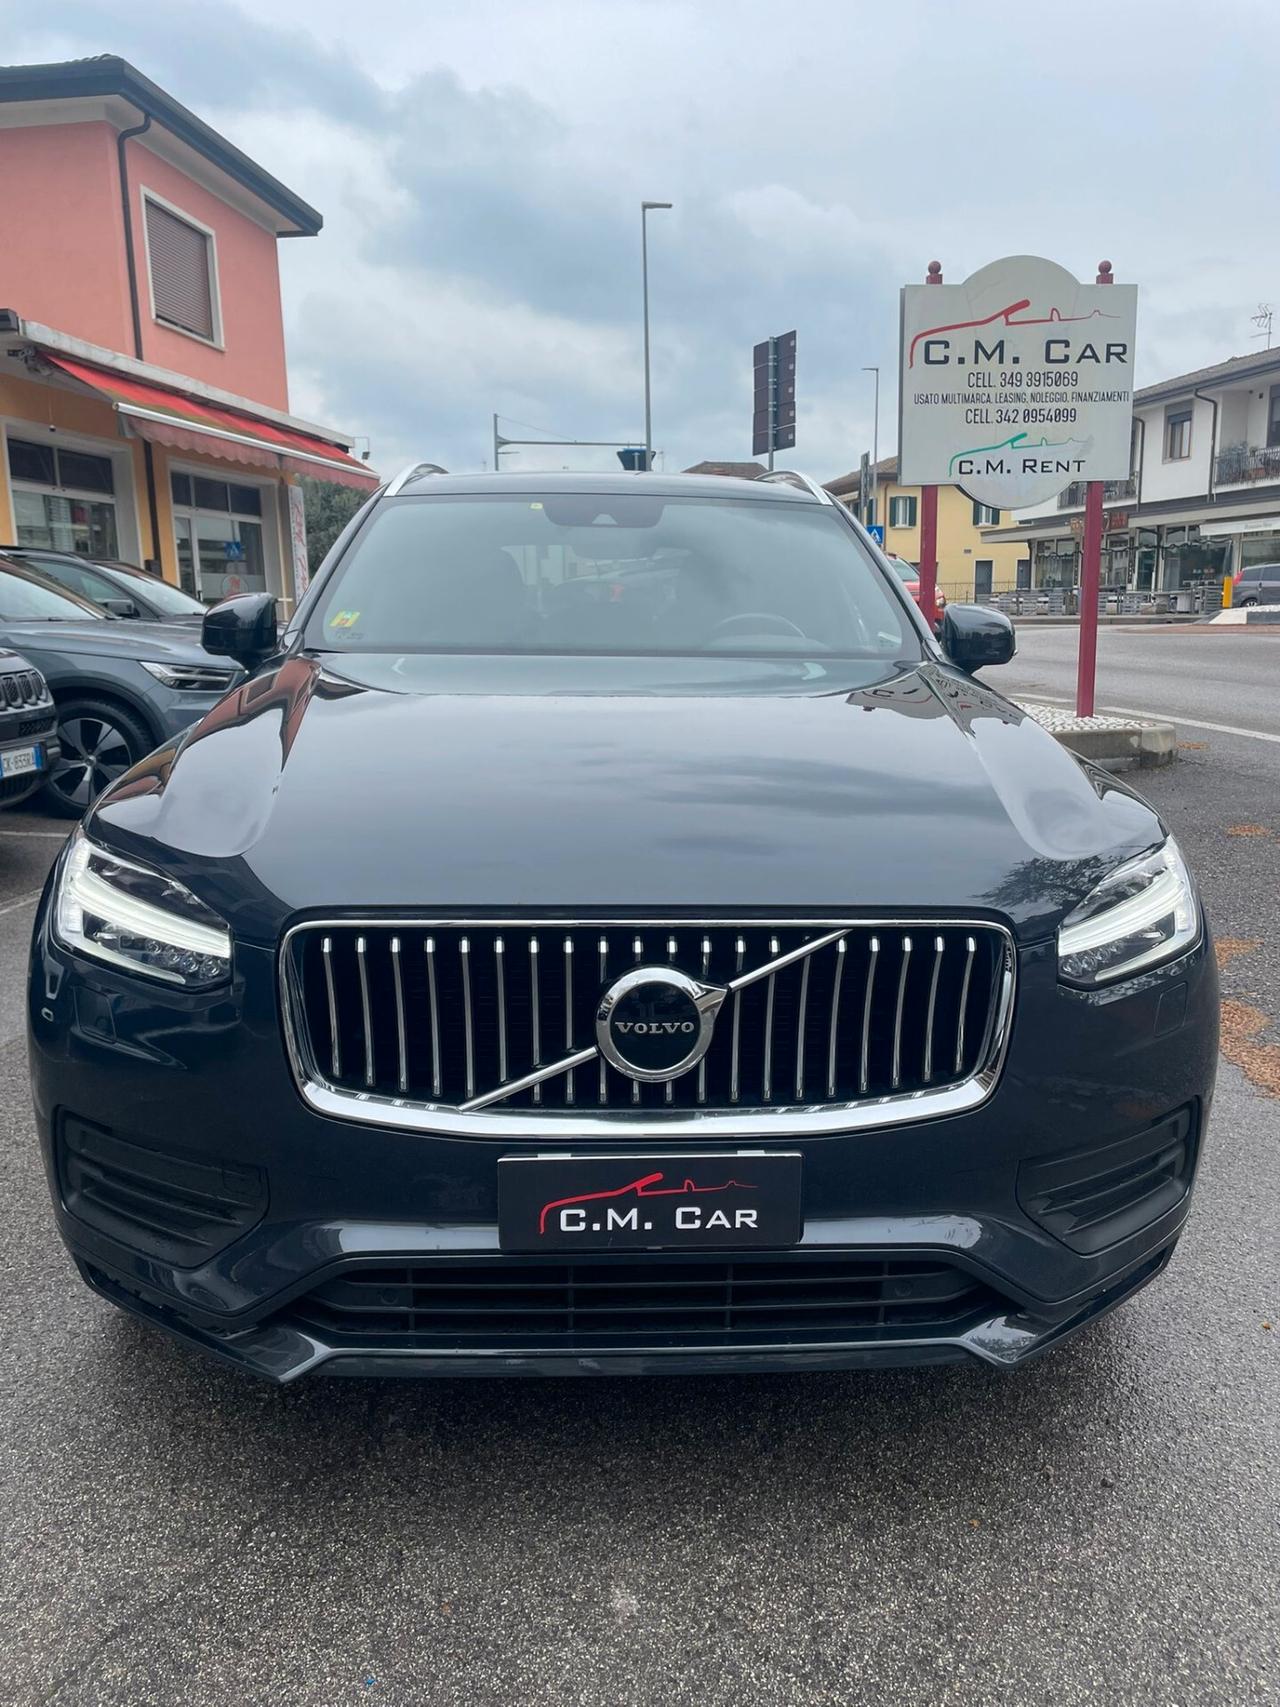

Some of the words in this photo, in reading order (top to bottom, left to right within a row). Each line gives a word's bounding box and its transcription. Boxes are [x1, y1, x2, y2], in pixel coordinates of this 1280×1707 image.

[924, 339, 1020, 365] C.M.
[1045, 339, 1128, 364] CAR
[967, 371, 996, 389] CELL.
[999, 370, 1023, 388] 349
[1026, 370, 1079, 388] 3915069
[913, 392, 940, 405] USATO
[1071, 389, 1130, 403] FINANZIAMENTI
[995, 408, 1020, 425] 342
[1023, 407, 1078, 424] 0954099
[958, 459, 1012, 475] C.M.
[1022, 457, 1087, 474] RENT
[614, 1021, 695, 1035] VOLVO
[559, 1206, 653, 1233] C.M.
[675, 1206, 759, 1231] CAR
